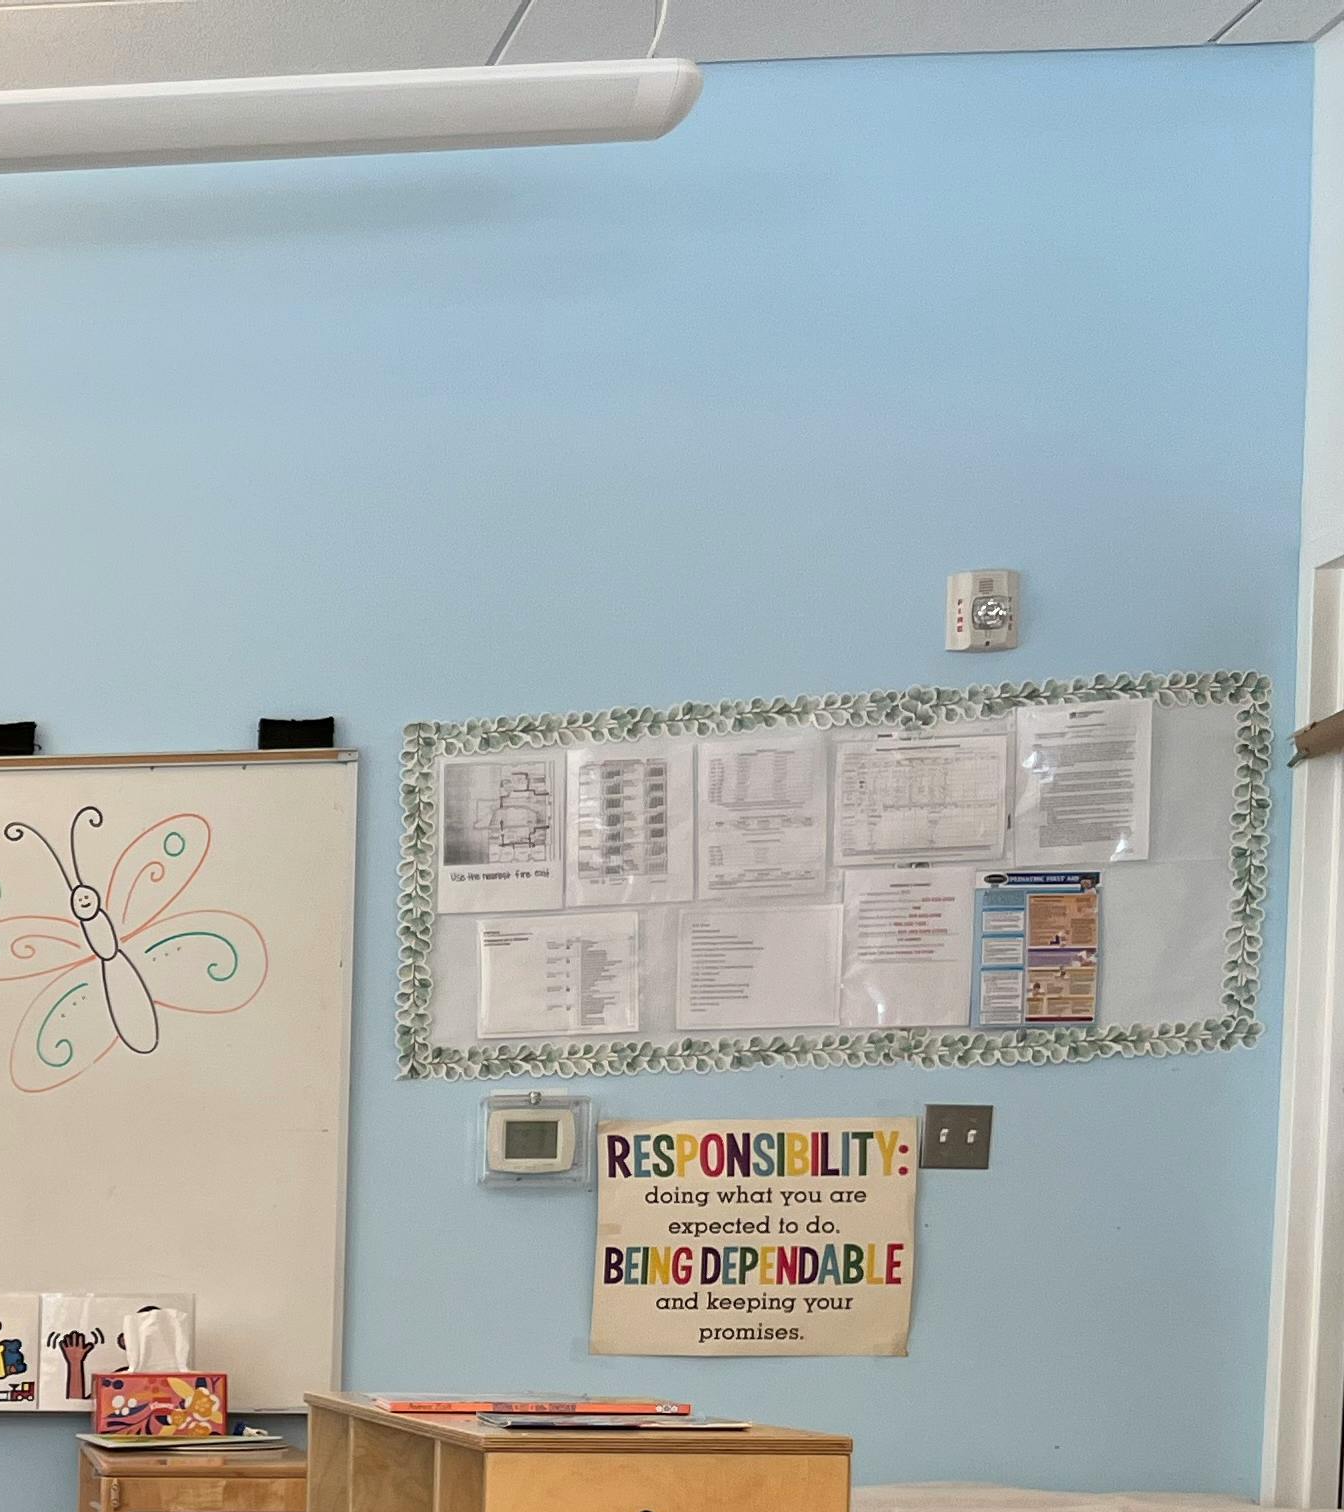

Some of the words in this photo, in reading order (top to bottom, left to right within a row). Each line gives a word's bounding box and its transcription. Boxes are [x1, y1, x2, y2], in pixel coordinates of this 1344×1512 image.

[607, 1131, 910, 1178] RESPONSIBILITY:
[644, 1186, 710, 1207] doing
[716, 1186, 773, 1204] what
[780, 1188, 823, 1207] you
[829, 1188, 867, 1204] are
[668, 1217, 770, 1238] expected
[778, 1217, 800, 1235] to
[805, 1217, 841, 1235] do.
[604, 1246, 693, 1285] BEING
[700, 1243, 905, 1285] DEPENDABLE
[655, 1292, 699, 1311] and
[706, 1292, 796, 1315] keeping
[802, 1296, 854, 1315] your
[698, 1323, 805, 1343] promises.
